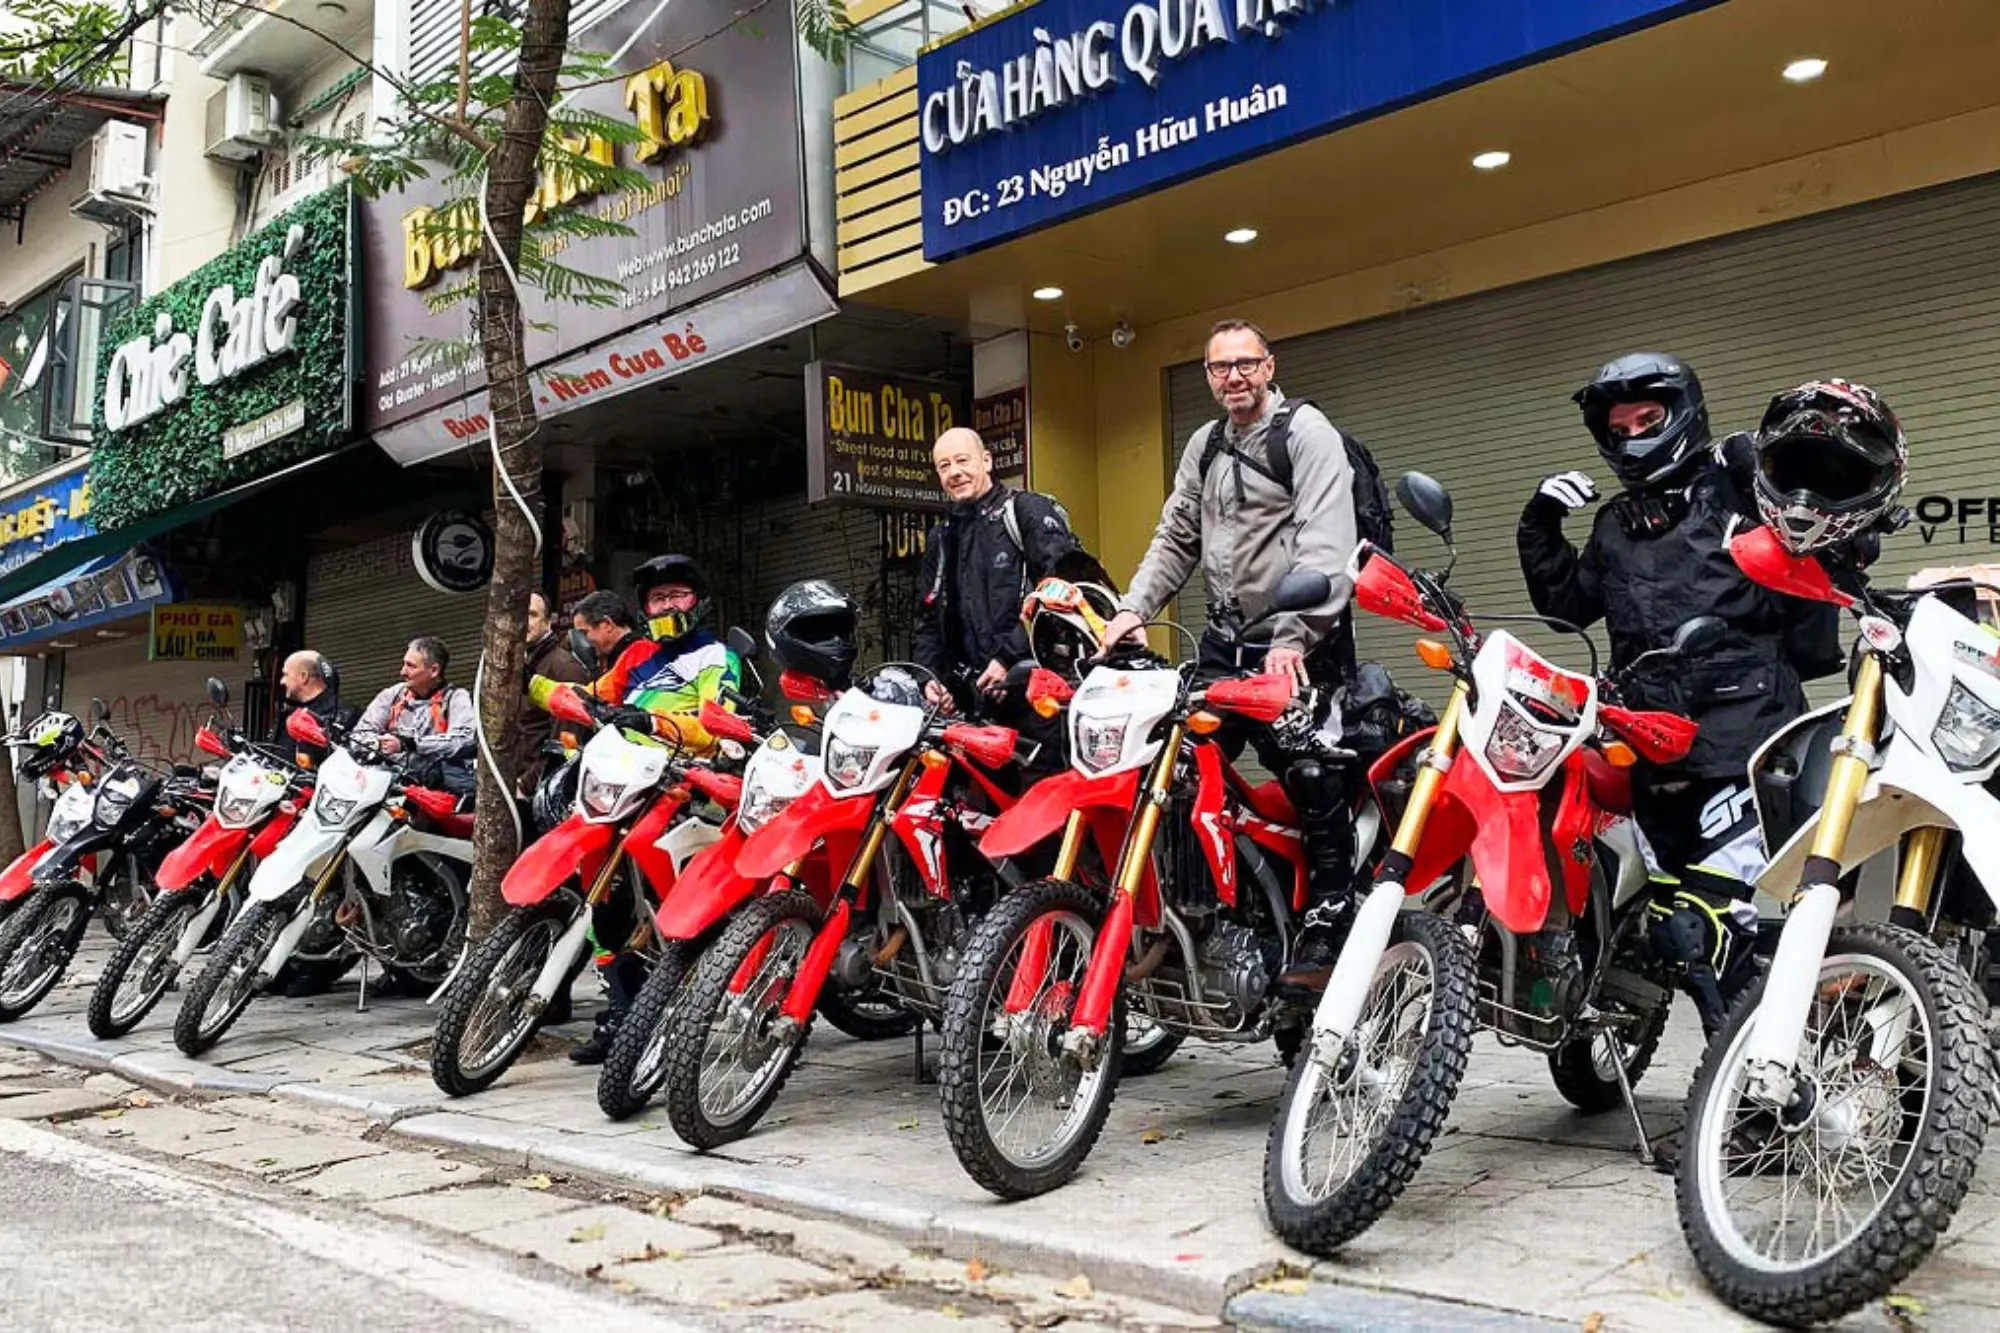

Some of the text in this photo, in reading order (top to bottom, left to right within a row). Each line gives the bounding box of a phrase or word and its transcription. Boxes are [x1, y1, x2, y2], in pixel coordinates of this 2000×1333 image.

[1003, 20, 1116, 124] HÀNG
[943, 82, 1288, 227] ĐC: 23 Nguyễn Hữu Huân
[692, 252, 717, 280] 269
[717, 242, 740, 269] 122
[548, 368, 612, 402] Nem
[609, 347, 665, 379] Cua
[829, 376, 874, 433] Bun
[881, 383, 925, 442] Cha
[833, 470, 851, 493] 21
